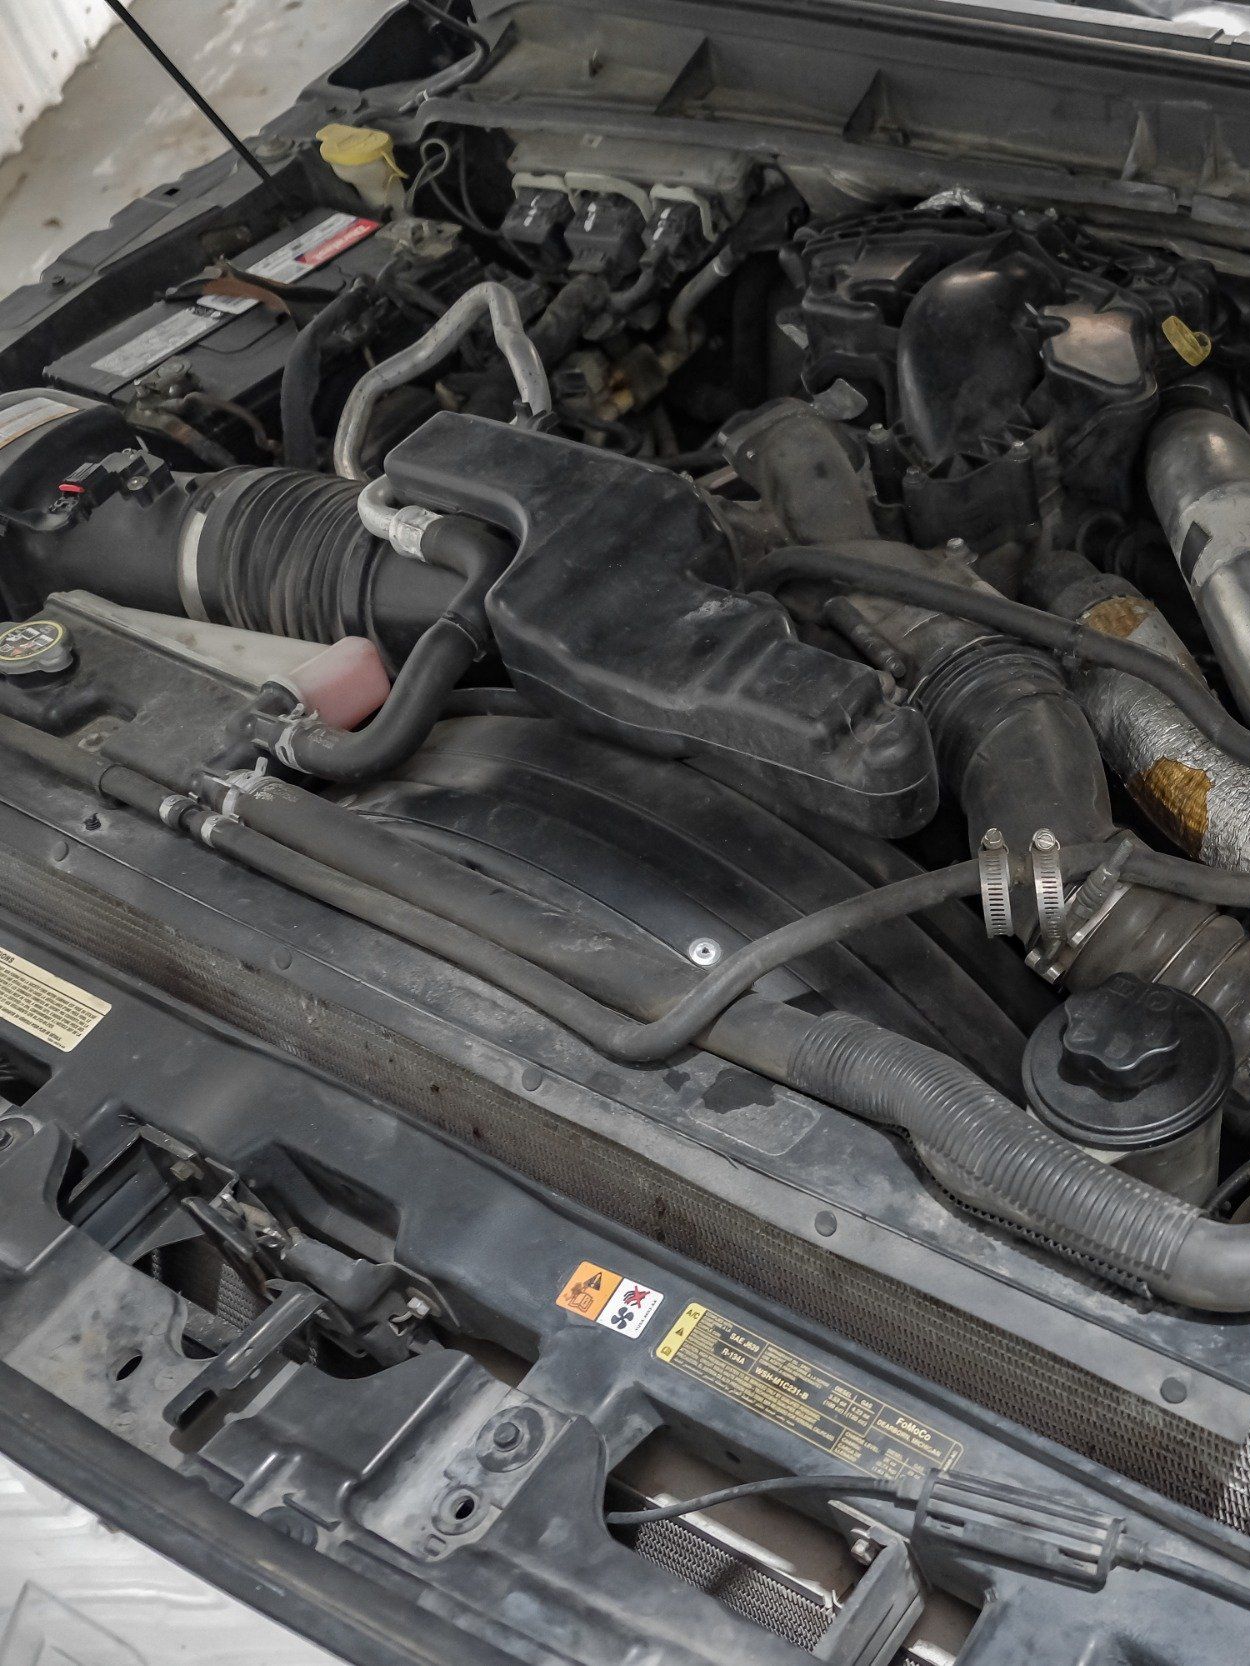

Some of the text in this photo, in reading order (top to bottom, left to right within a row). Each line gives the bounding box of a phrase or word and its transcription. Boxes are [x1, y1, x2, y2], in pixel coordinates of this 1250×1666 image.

[685, 1308, 700, 1319] A/C
[729, 1332, 744, 1344] SAE
[720, 1348, 745, 1365] R-134A
[753, 1366, 809, 1400] WSH-M1C231-B
[875, 1419, 911, 1441] DEARBORN,
[895, 1417, 933, 1441] FoMoCo
